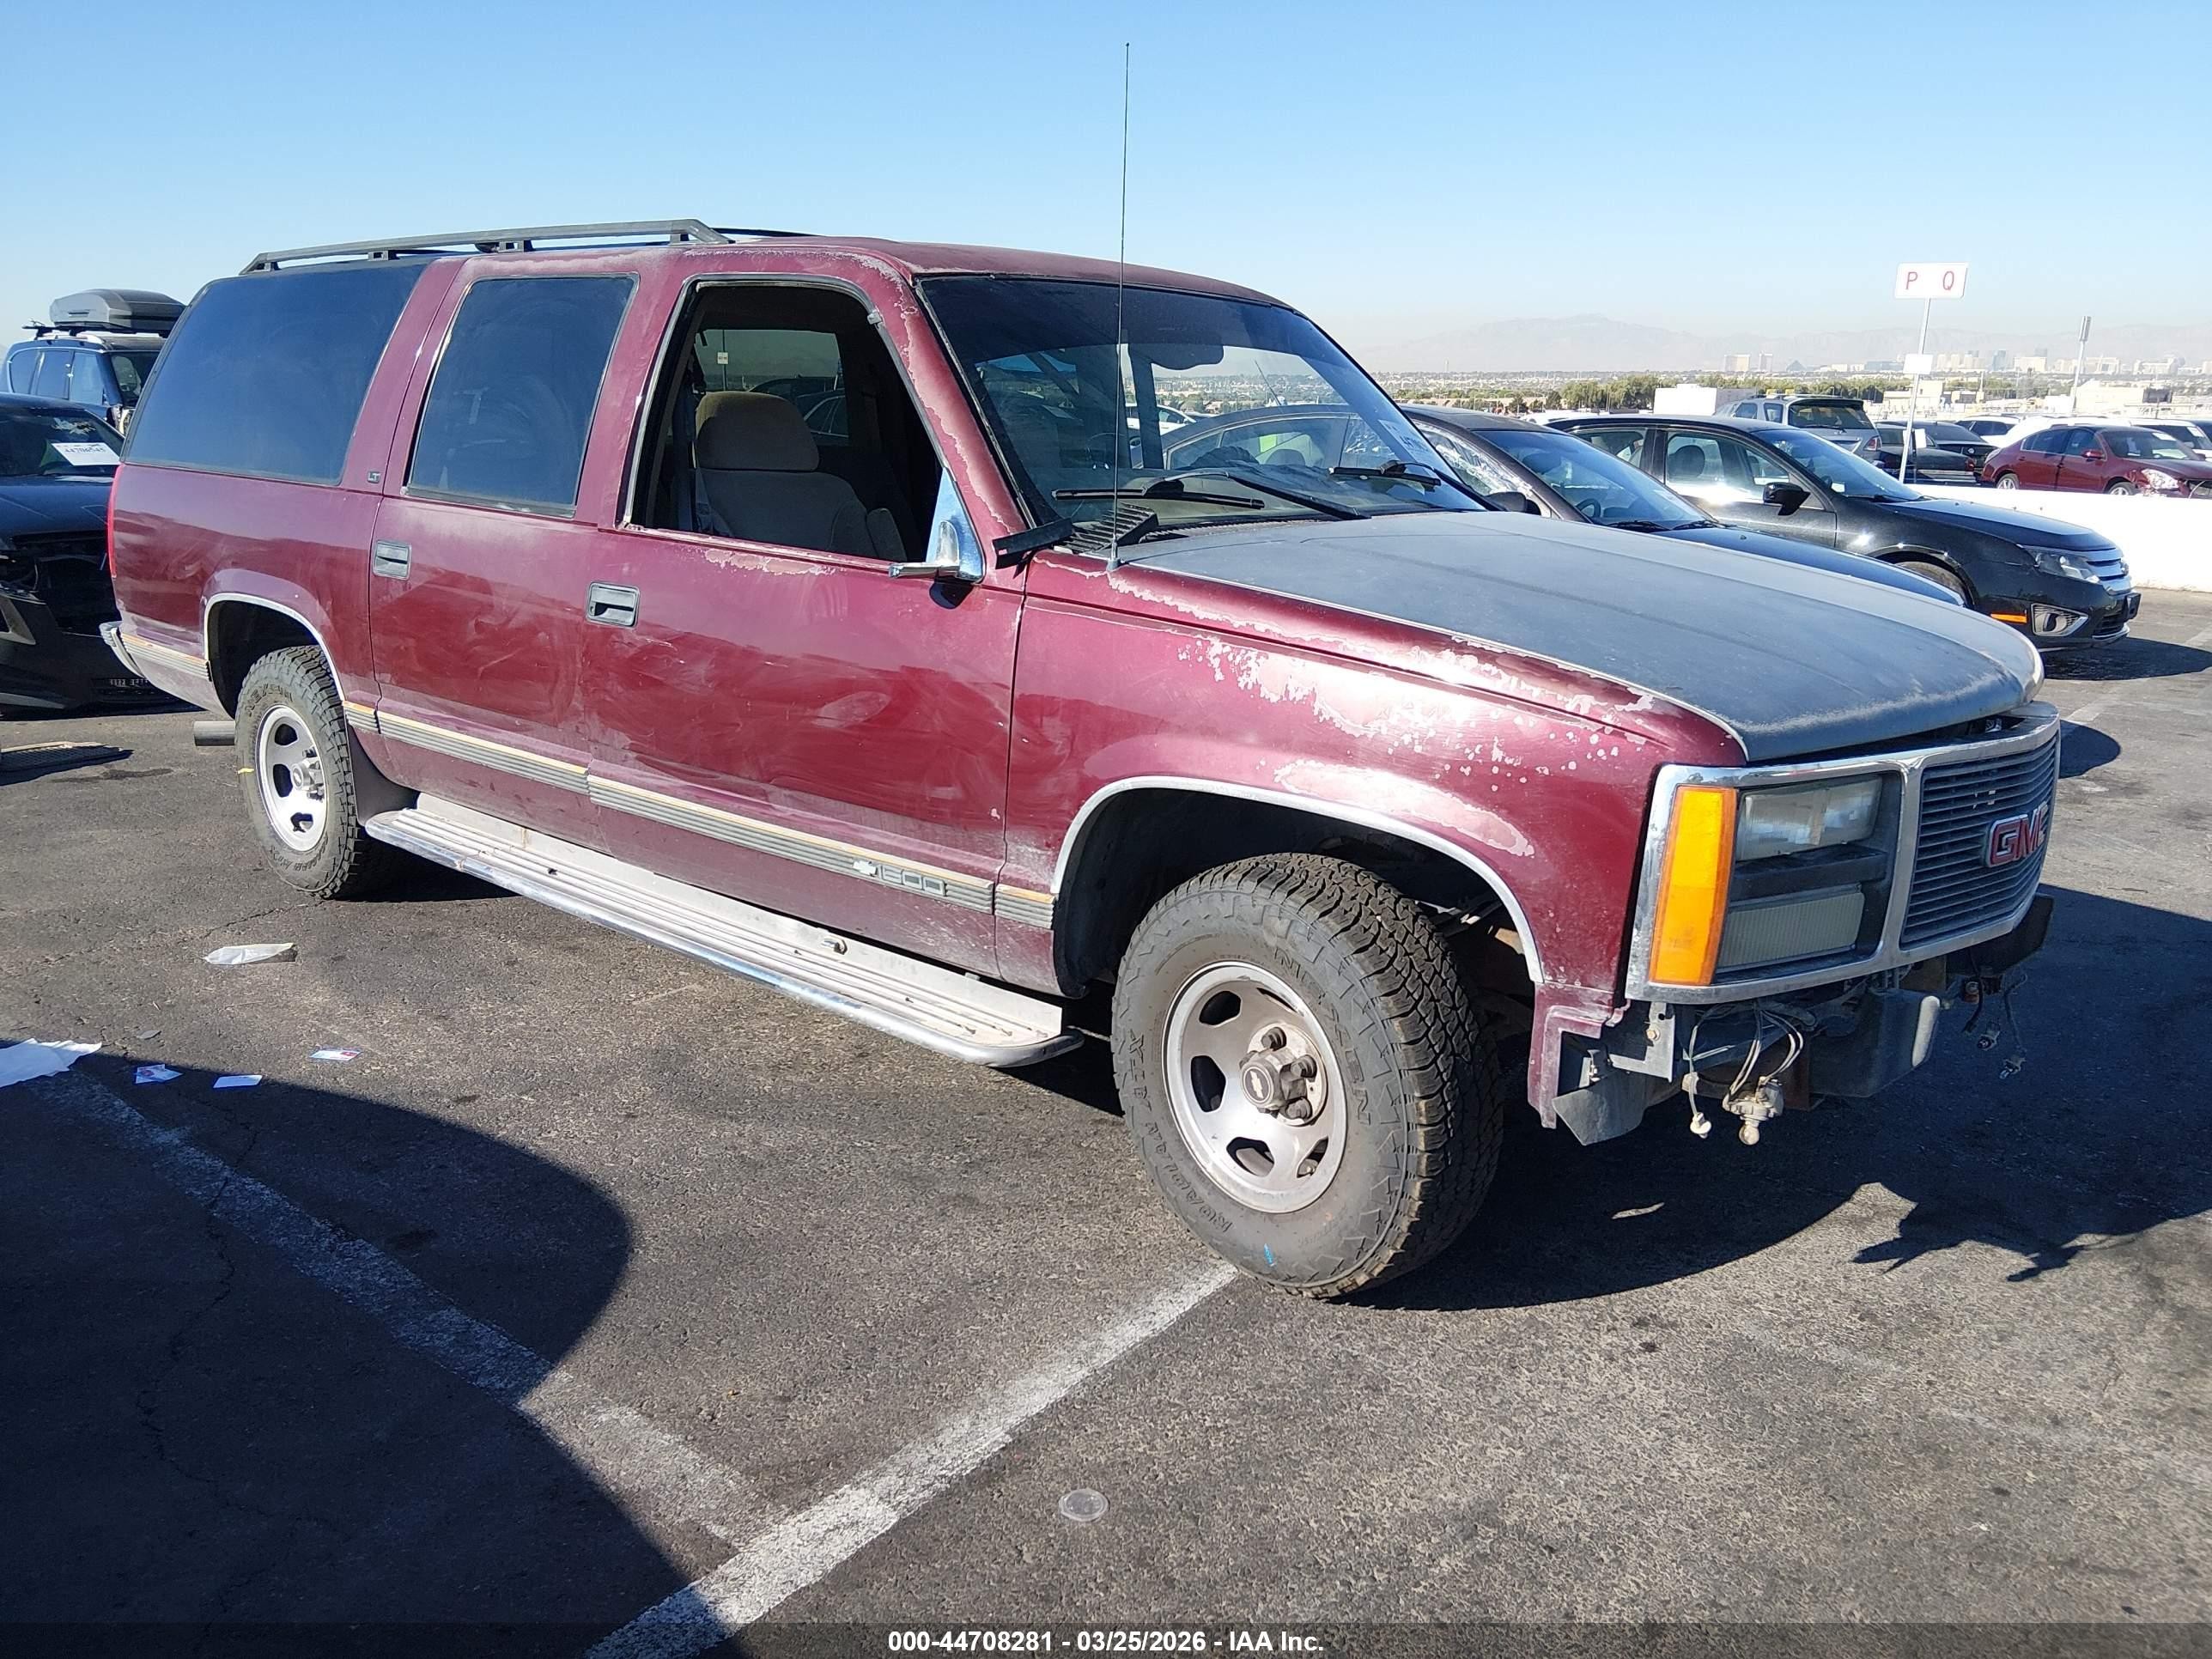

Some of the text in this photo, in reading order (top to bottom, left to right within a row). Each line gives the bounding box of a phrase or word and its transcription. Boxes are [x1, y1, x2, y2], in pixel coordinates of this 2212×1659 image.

[1905, 270, 1955, 291] P Q
[1988, 800, 2049, 868] GMC
